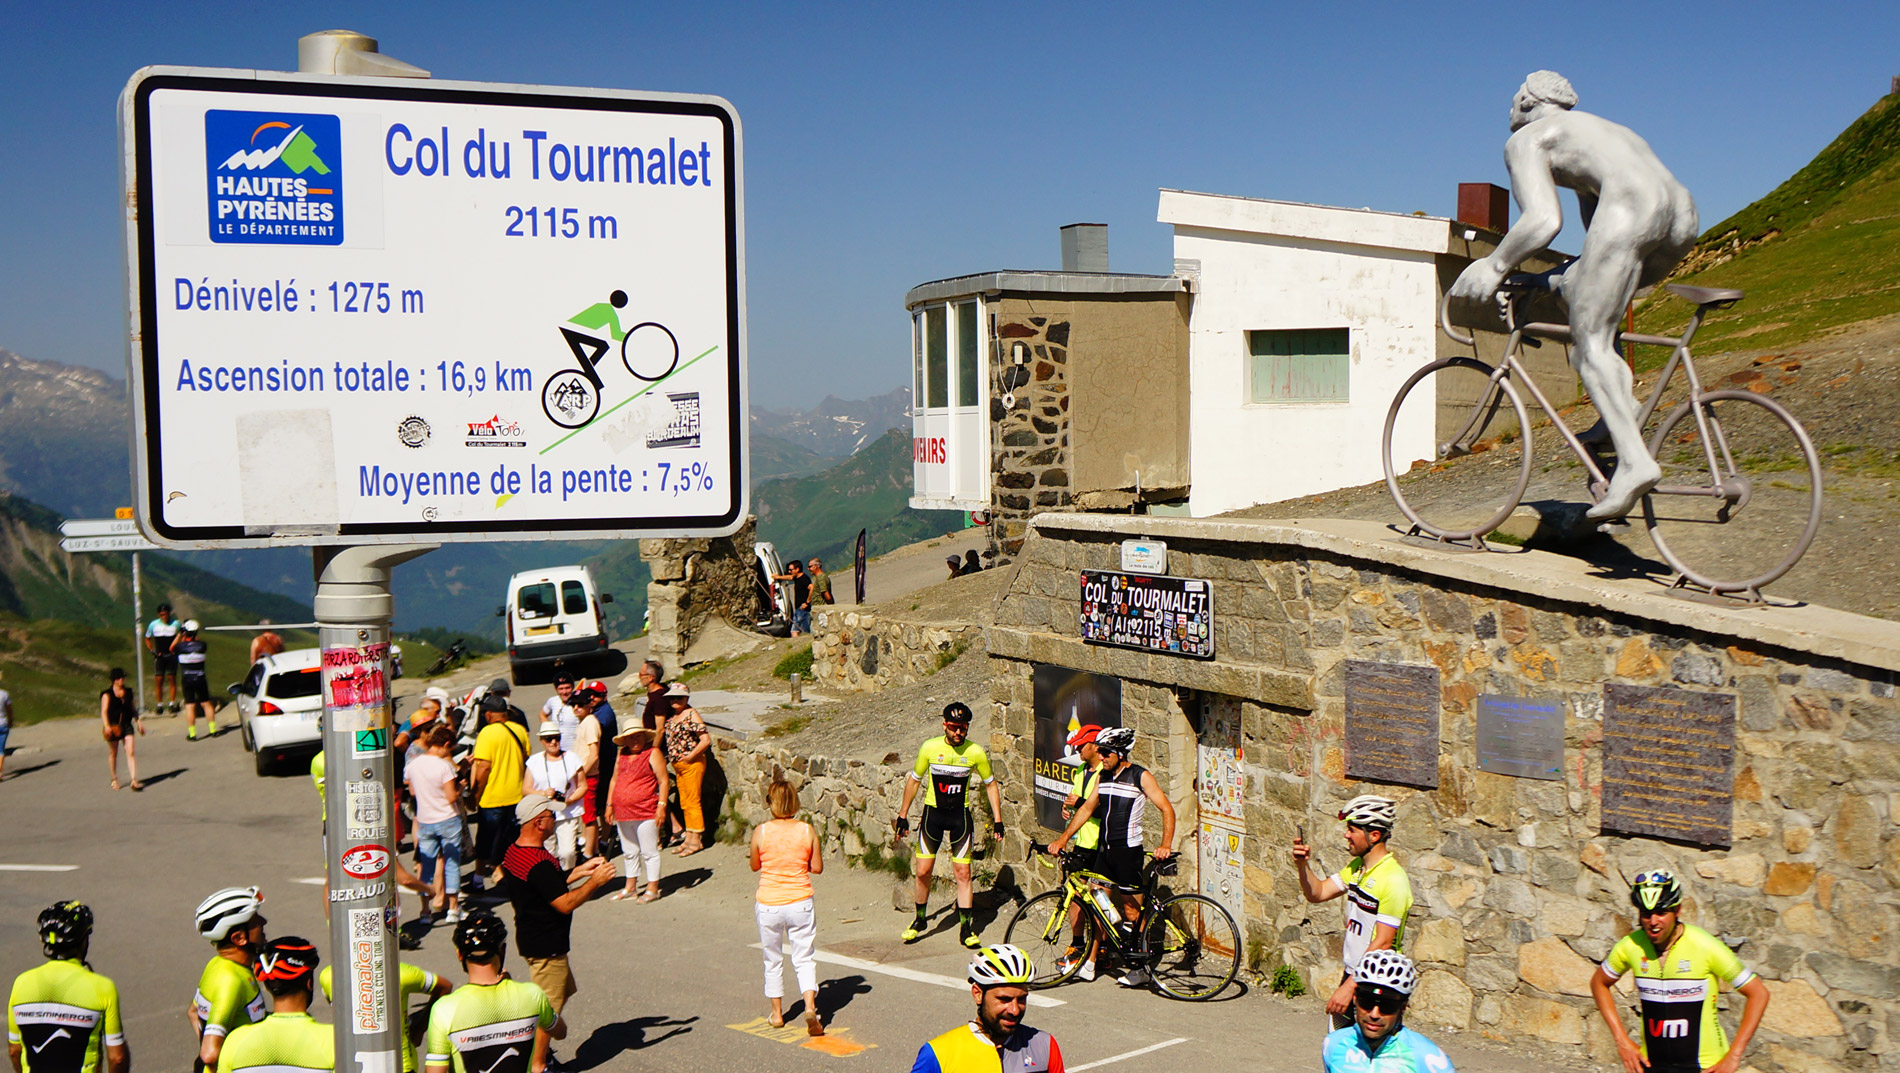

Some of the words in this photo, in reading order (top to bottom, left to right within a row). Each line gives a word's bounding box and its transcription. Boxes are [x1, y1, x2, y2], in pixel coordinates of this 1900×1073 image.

[386, 122, 450, 177] Col
[463, 127, 511, 180] du
[522, 129, 712, 187] Tourmalet
[218, 223, 233, 235] LE
[240, 222, 334, 236] DÉPARTEMENT
[505, 205, 580, 239] 2115
[589, 215, 618, 240] m
[175, 276, 299, 313] Dénivelé
[329, 281, 391, 314] 1275
[402, 289, 425, 314] m
[176, 358, 325, 392] Ascension
[334, 359, 410, 392] totale
[437, 360, 487, 398] 16,9
[495, 360, 533, 392] km
[550, 392, 592, 408] VARP
[360, 464, 481, 505] Moyenne
[490, 463, 522, 494] de
[531, 463, 553, 494] la
[562, 463, 633, 502] pente
[657, 461, 714, 498] 7,5%
[118, 510, 125, 518] D
[1085, 583, 1108, 604] COL
[1111, 592, 1123, 605] DU
[1127, 586, 1207, 615] TOURMALET
[351, 828, 385, 838] ROUTE
[331, 882, 386, 902] BERAUD
[353, 941, 379, 1030] pirenaica
